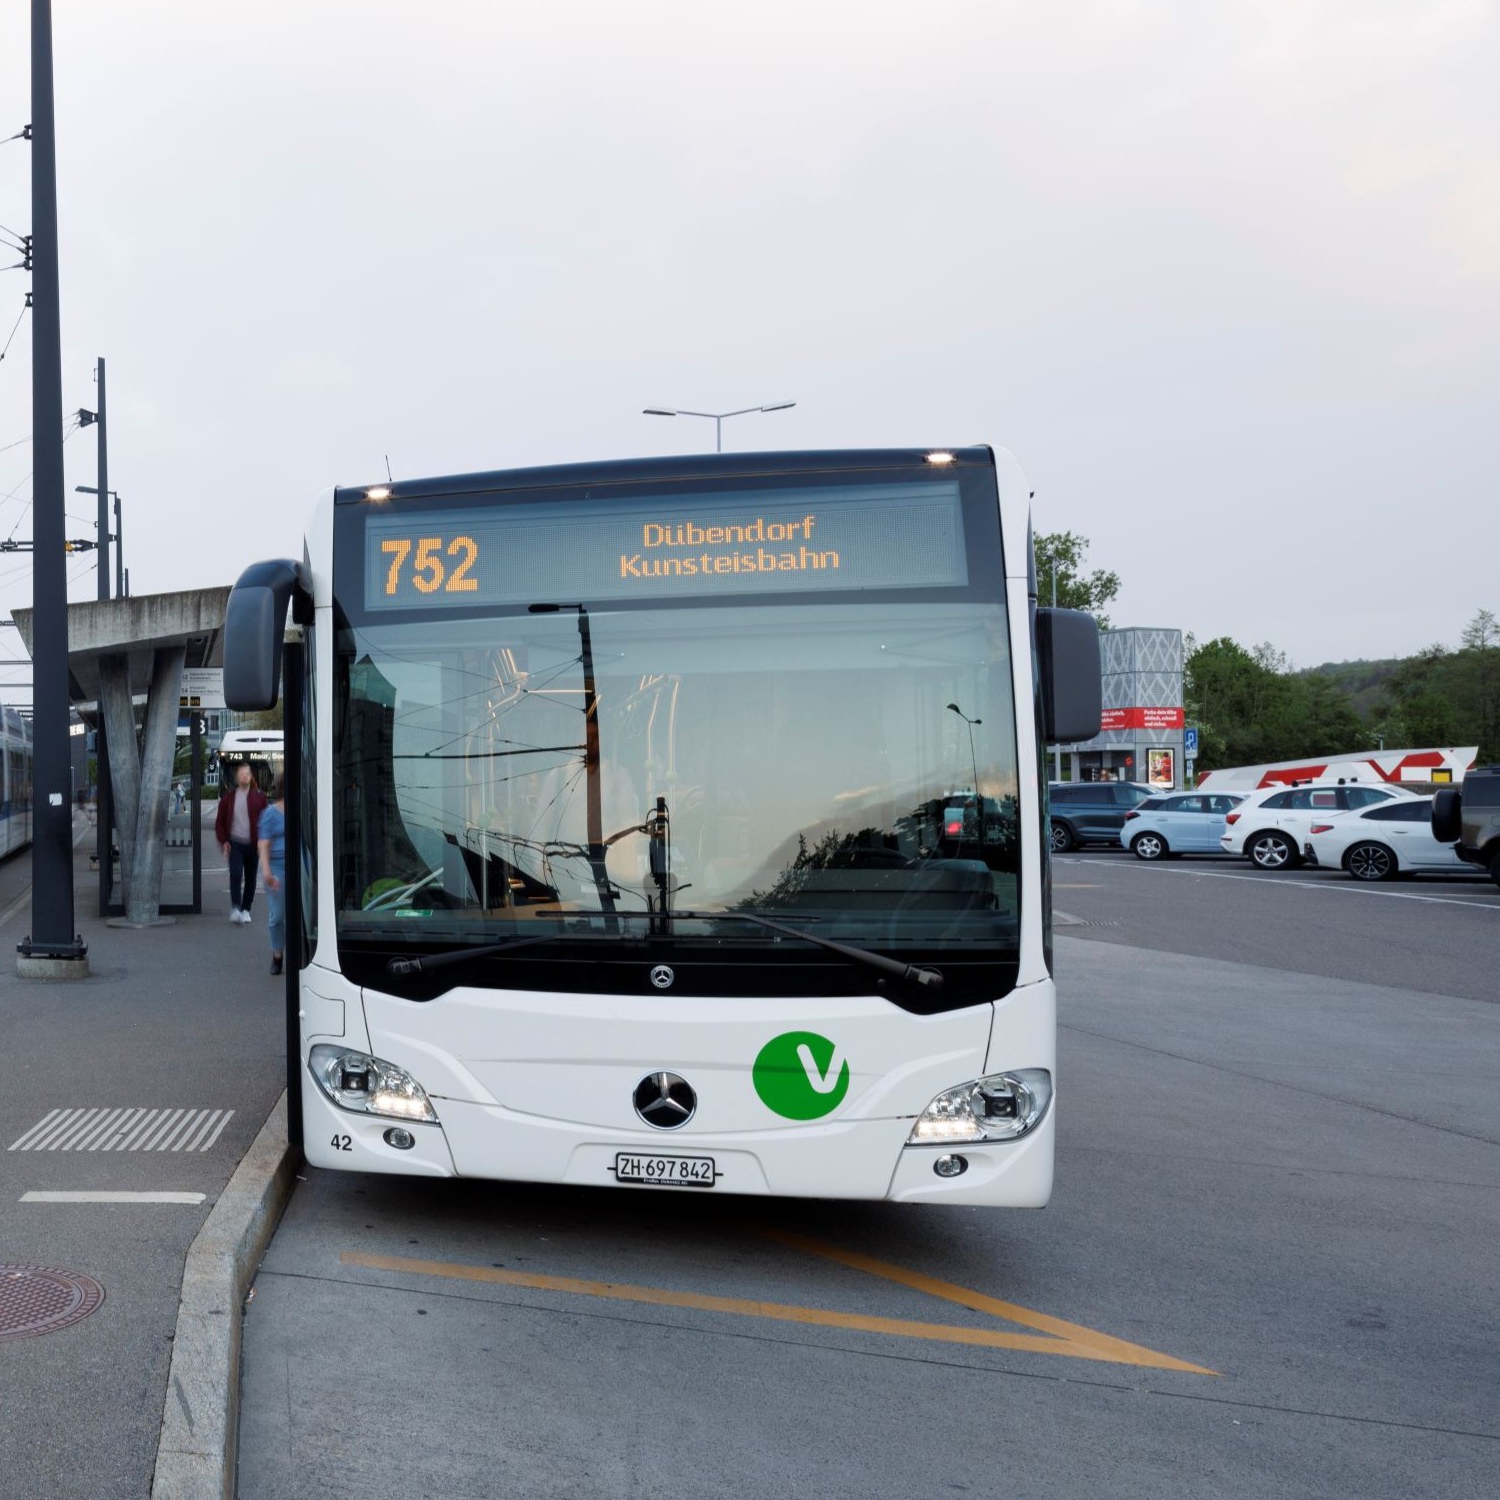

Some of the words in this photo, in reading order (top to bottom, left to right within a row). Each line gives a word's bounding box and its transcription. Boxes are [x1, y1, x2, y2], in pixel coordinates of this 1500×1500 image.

[643, 516, 815, 548] Dübendorf
[381, 536, 478, 594] 752
[620, 546, 840, 577] Kunsteisbahn
[229, 752, 243, 760] 743
[330, 1134, 353, 1151] 42
